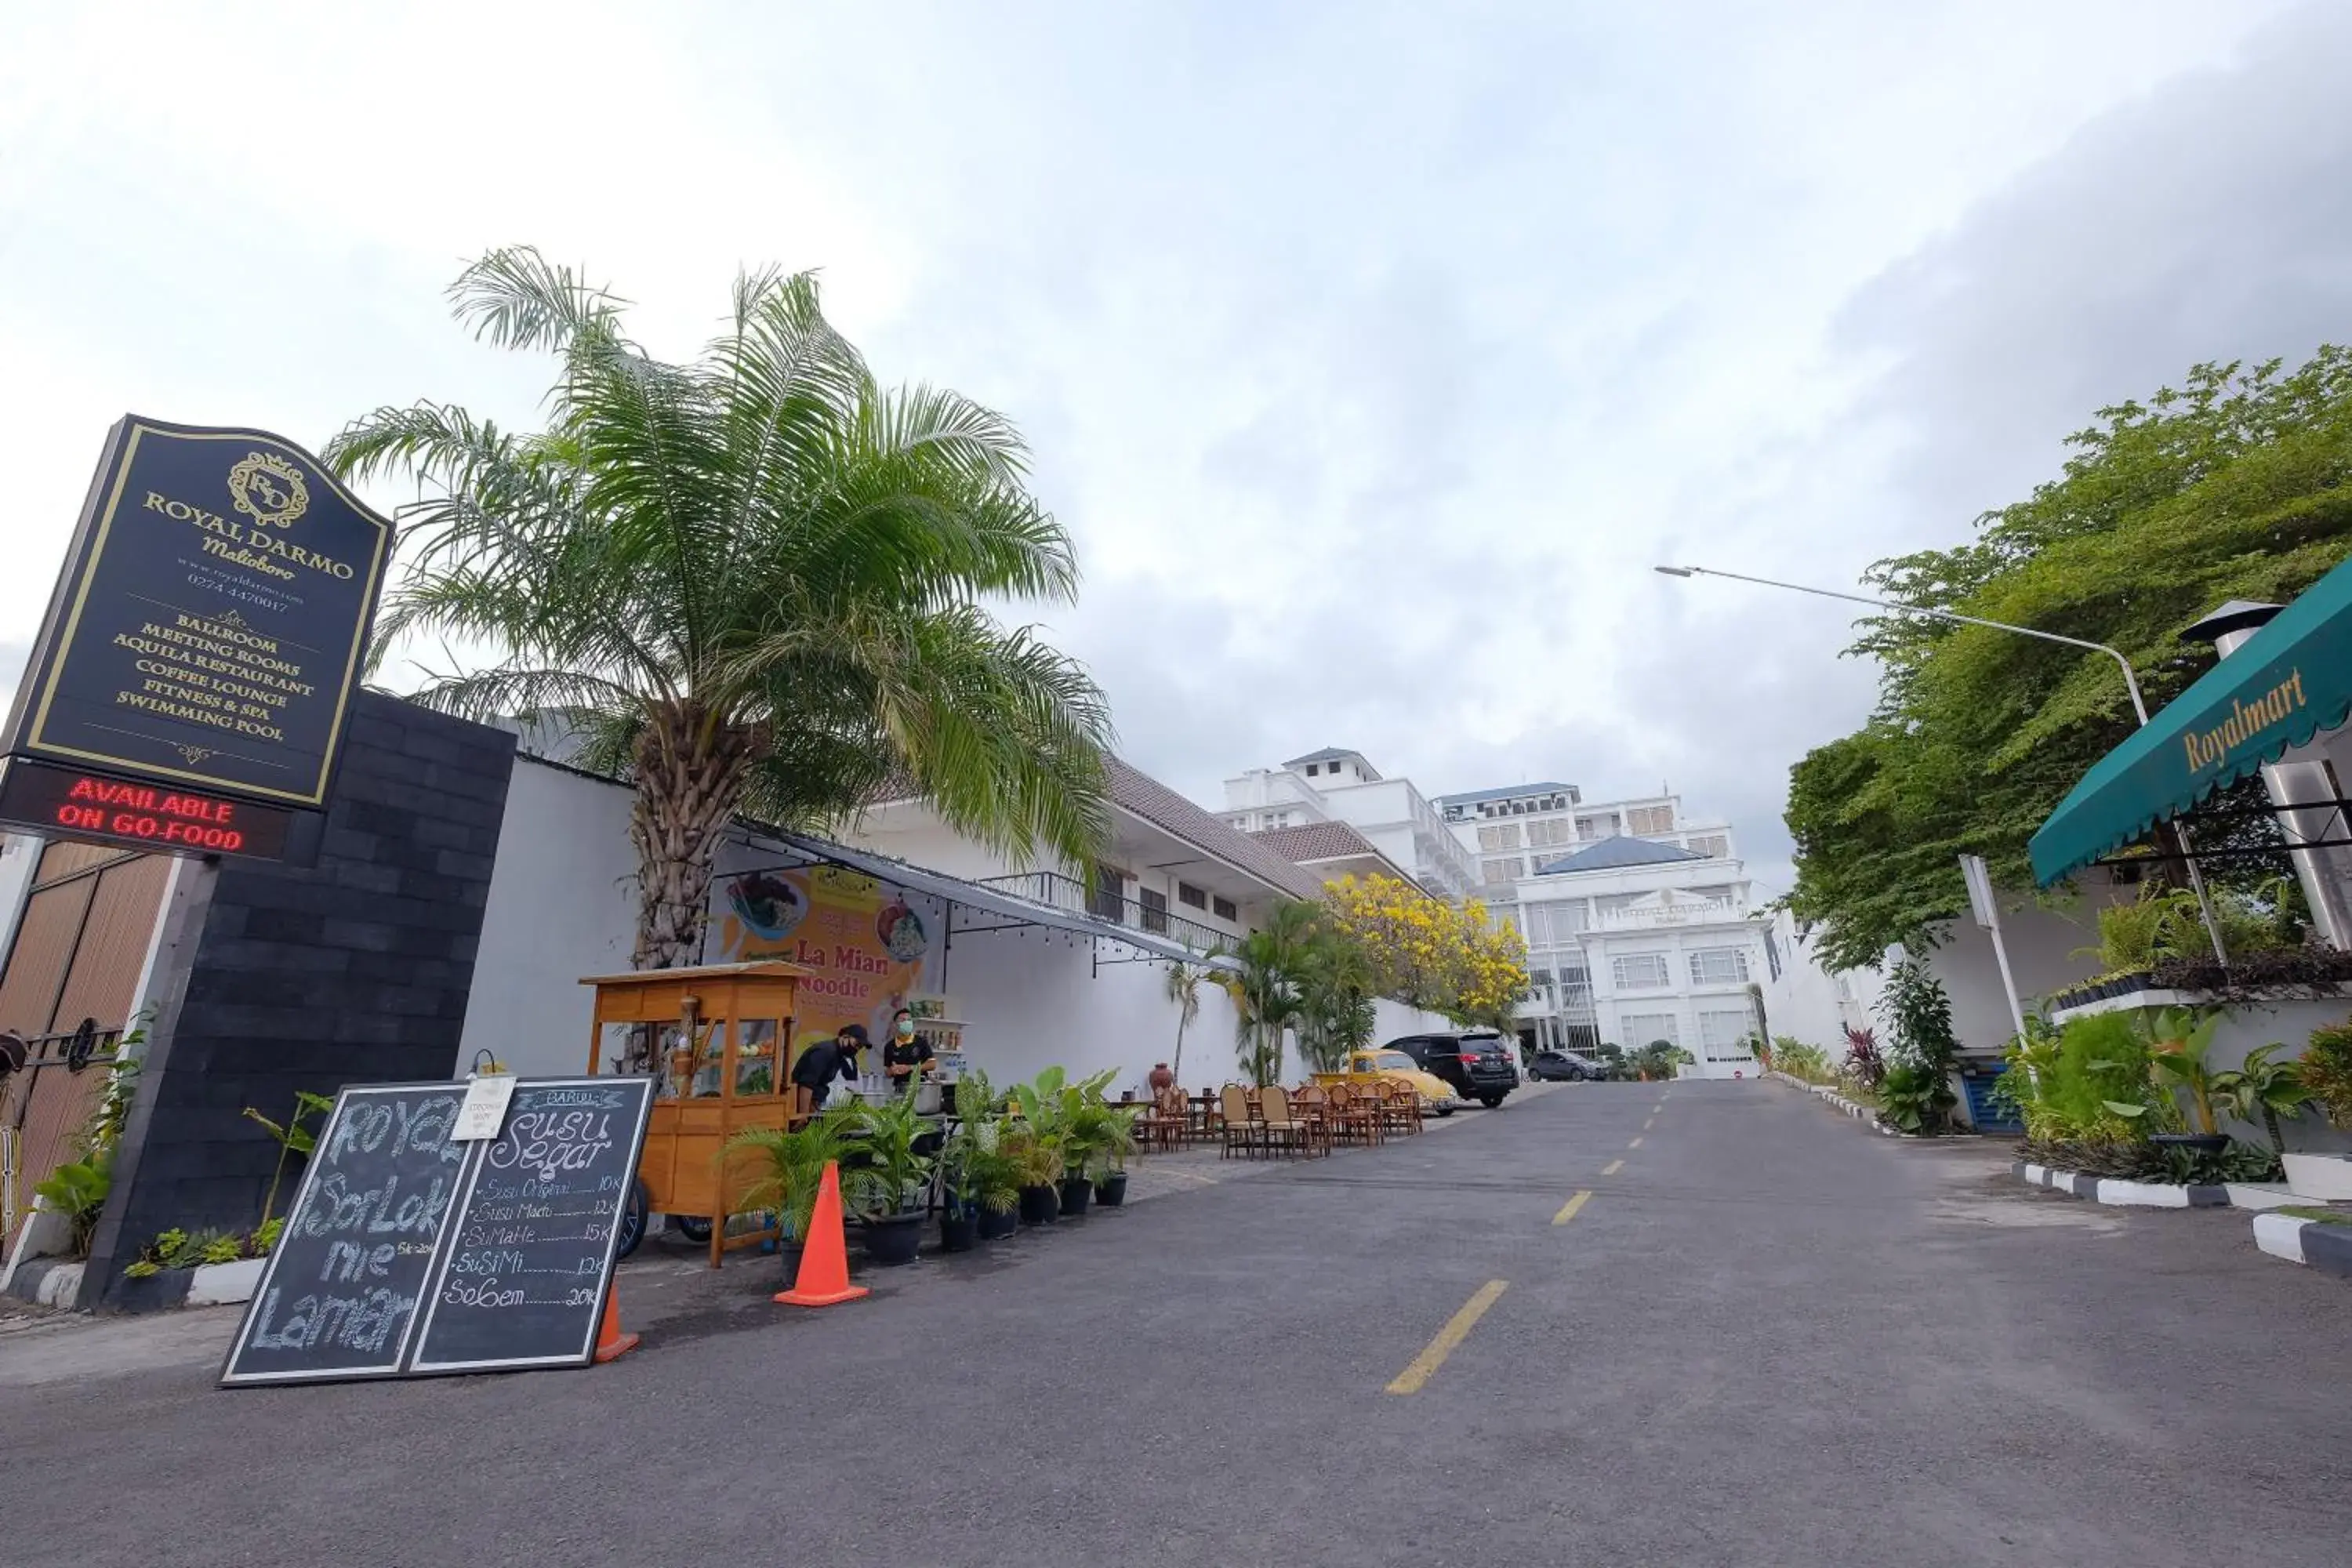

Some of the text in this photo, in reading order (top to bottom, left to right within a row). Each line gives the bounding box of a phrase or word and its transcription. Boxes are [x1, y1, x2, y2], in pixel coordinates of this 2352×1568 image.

[143, 491, 354, 579] ROYAL DARMO
[203, 536, 296, 580] Malioboro
[140, 622, 301, 677] MEETING ROOMS
[176, 614, 277, 654] BALLROOM
[113, 633, 314, 696] AQUILA RESTAURANT
[136, 659, 288, 709] COFFEE LOUNGE
[116, 691, 284, 742] SWIMMING POOL
[143, 679, 270, 721] FITNESS & SPA
[2183, 666, 2307, 775] Royalmart
[57, 804, 104, 829] ON
[69, 776, 234, 824] AVAILABLE
[797, 938, 889, 976] La Mian
[796, 976, 869, 997] Noodle
